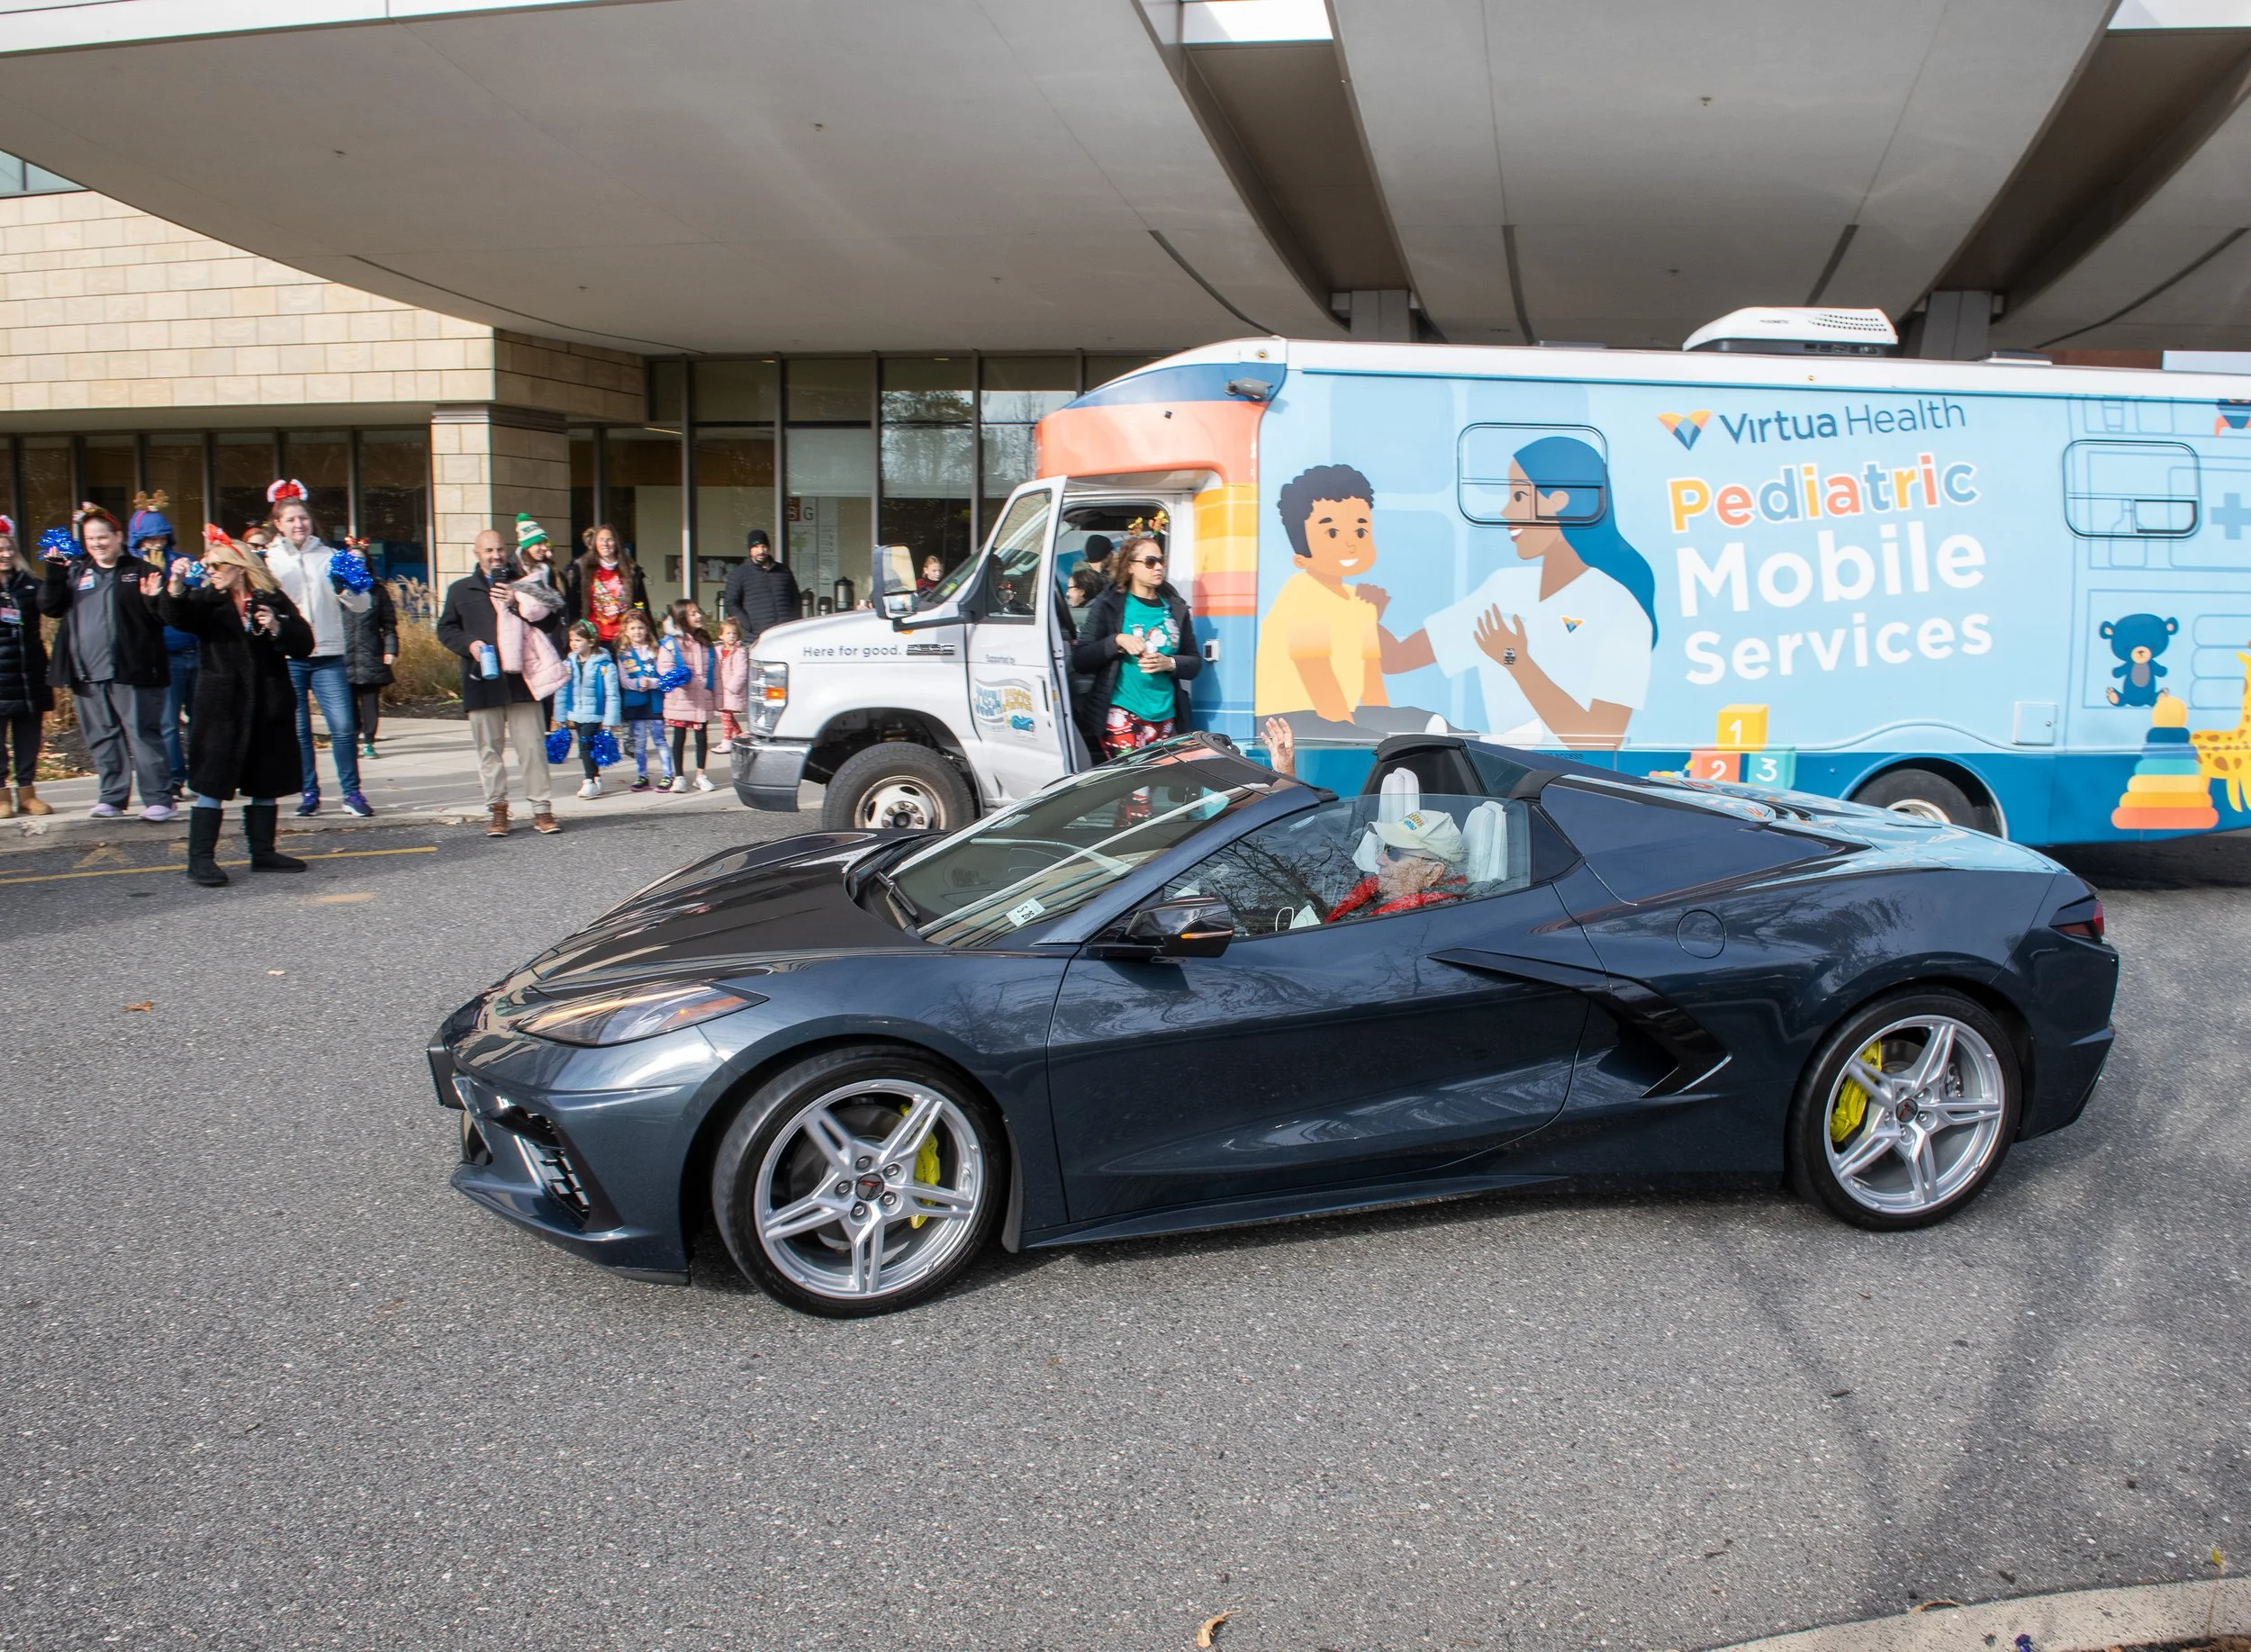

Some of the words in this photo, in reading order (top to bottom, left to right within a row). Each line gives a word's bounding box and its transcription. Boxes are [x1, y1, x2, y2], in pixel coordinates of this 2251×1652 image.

[1719, 411, 1838, 445] Virtua
[1845, 398, 1966, 437] Health
[1668, 453, 1980, 534] Pediatric
[1676, 521, 1986, 618] Mobile
[803, 645, 834, 657] Here
[839, 645, 858, 656] for
[863, 645, 902, 658] good.
[1684, 612, 1993, 685] Services
[1729, 718, 1742, 746] 1
[1708, 759, 1728, 781] 2
[1755, 757, 1778, 782] 3
